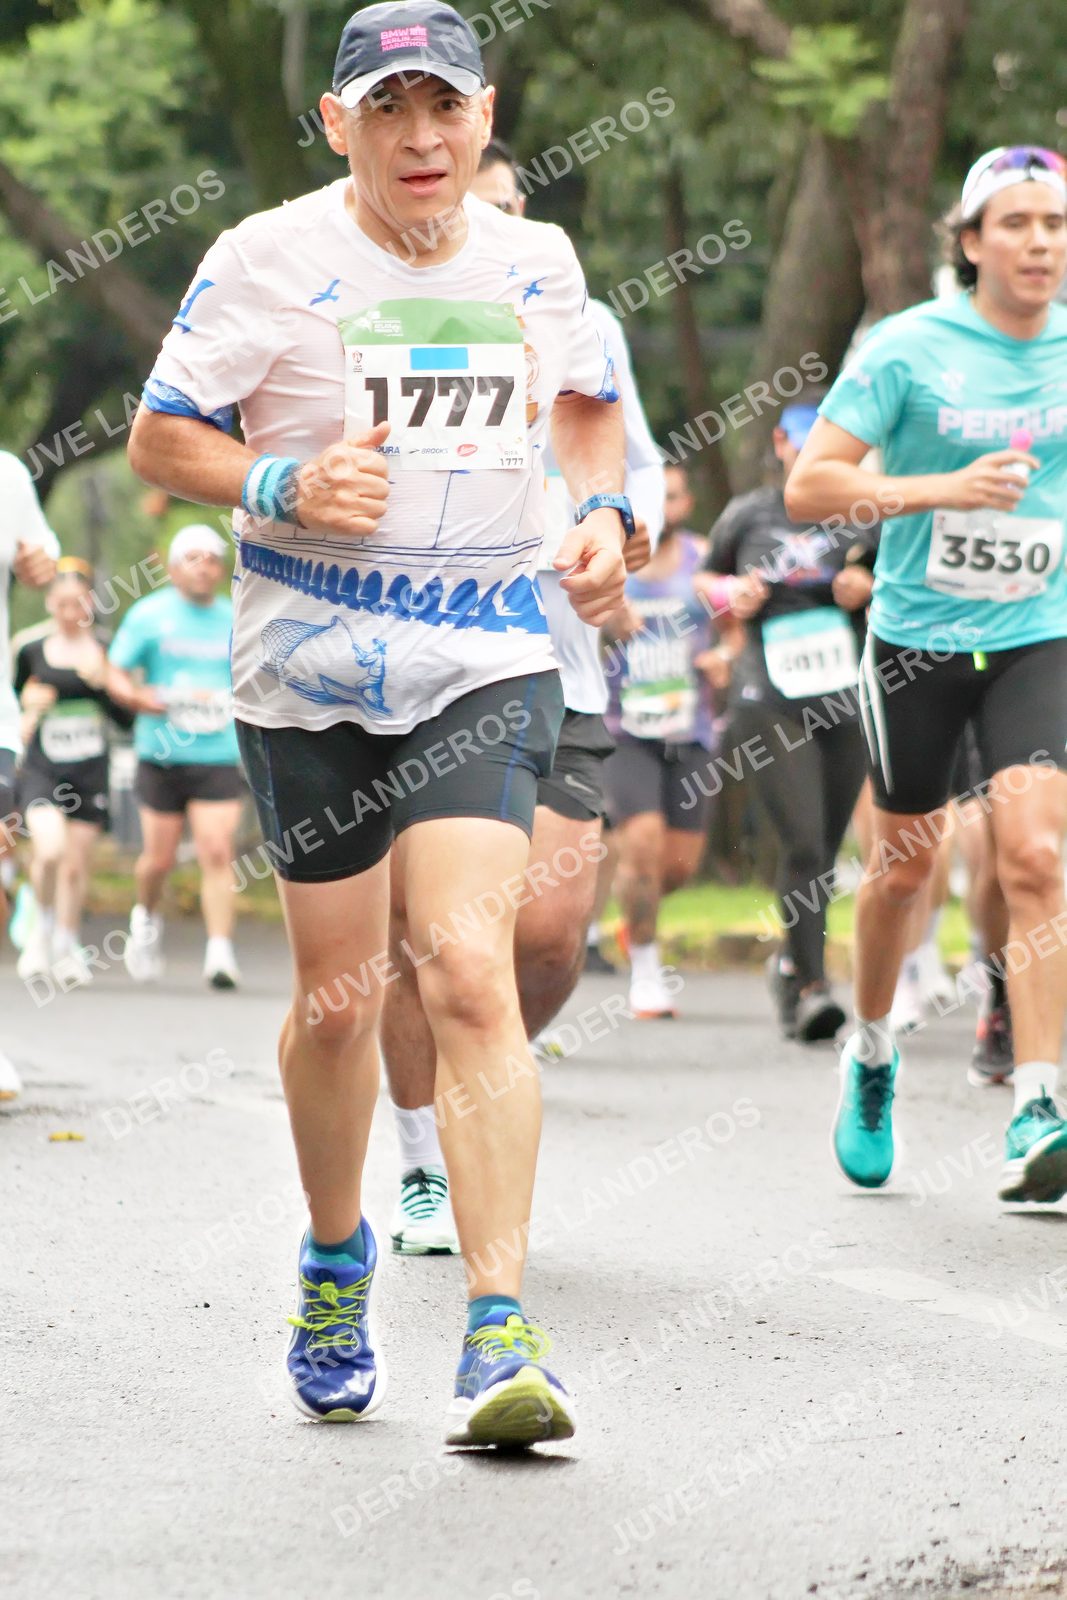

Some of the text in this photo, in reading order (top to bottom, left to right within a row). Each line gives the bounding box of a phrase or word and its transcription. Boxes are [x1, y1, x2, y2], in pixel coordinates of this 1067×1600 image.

[380, 28, 409, 40] BMW
[381, 36, 411, 46] BERLIN
[381, 41, 428, 52] MARATHON
[365, 376, 515, 428] 1777
[421, 447, 449, 455] BROOKS
[500, 458, 525, 467] 1777
[940, 534, 1051, 574] 3530
